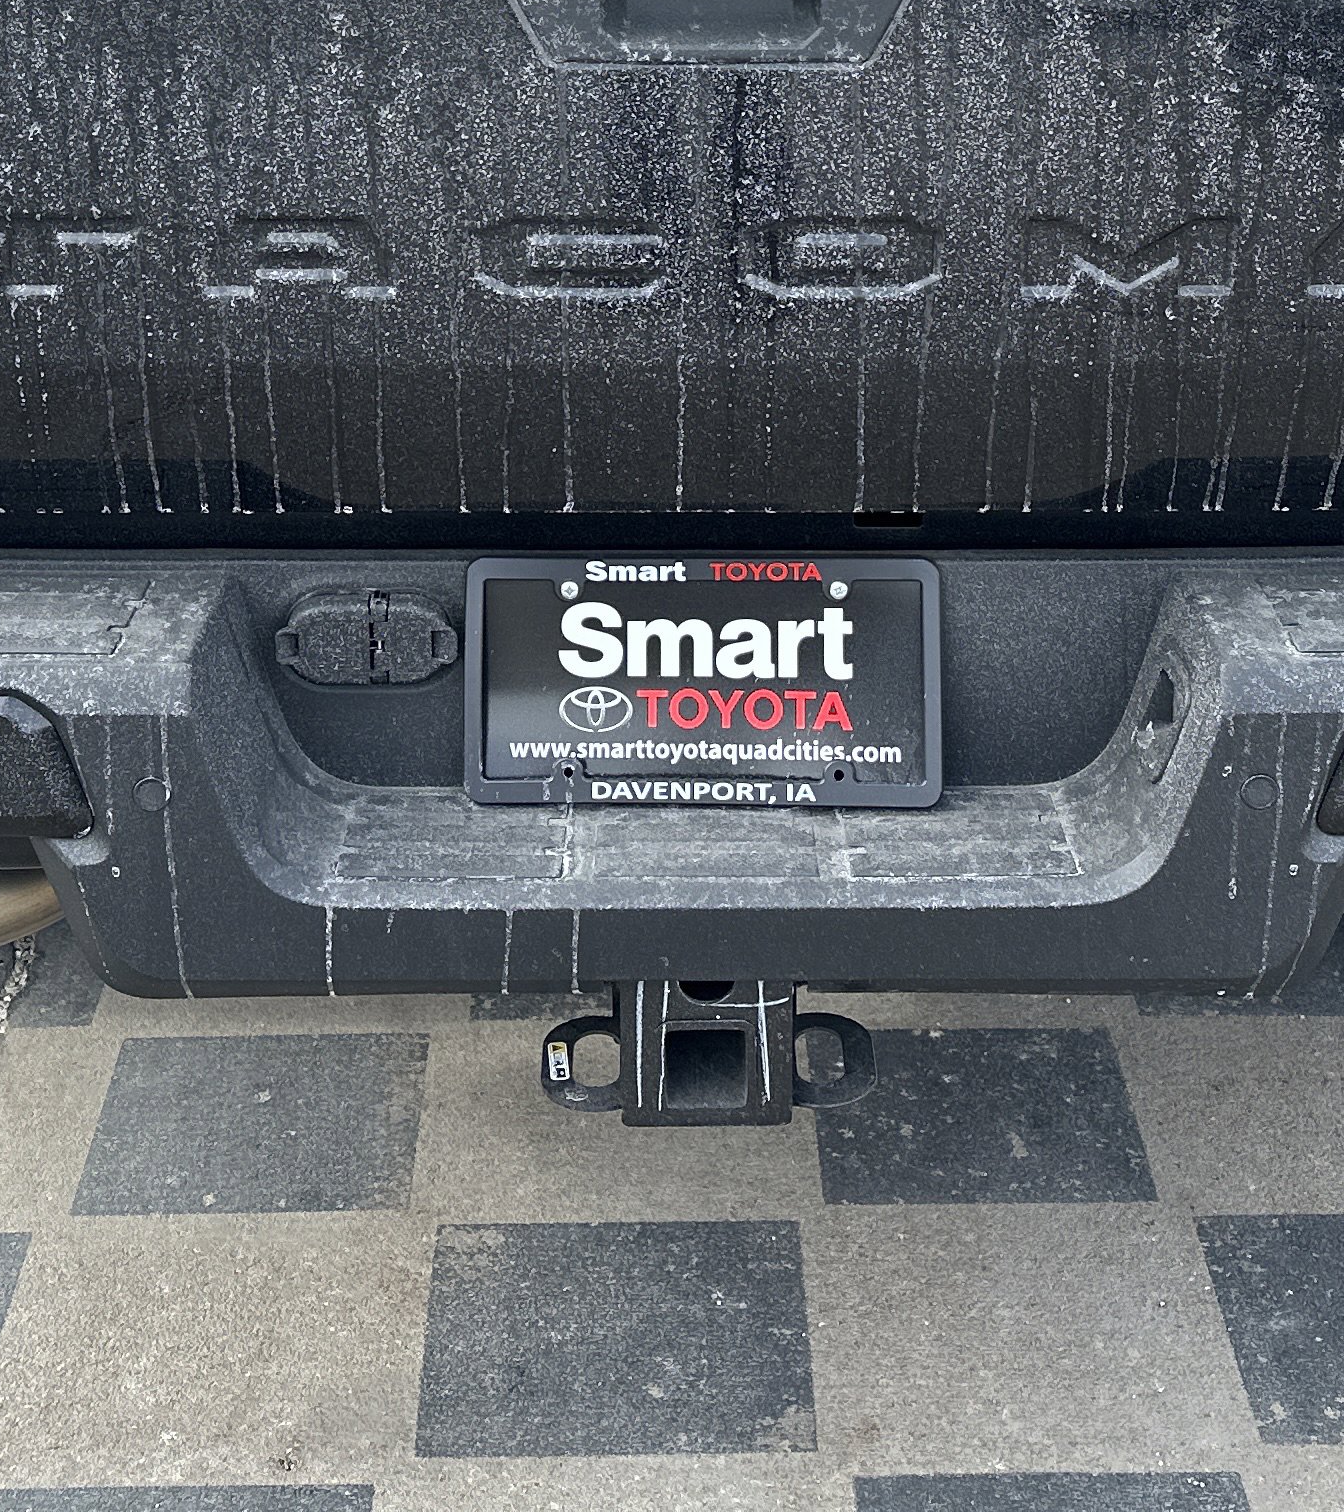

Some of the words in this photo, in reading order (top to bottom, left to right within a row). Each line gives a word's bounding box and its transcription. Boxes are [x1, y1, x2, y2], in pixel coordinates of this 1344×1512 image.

[585, 560, 687, 582] Smart
[709, 561, 823, 582] TOYOTA
[558, 601, 854, 681] Smart
[635, 687, 854, 732] TOYOTA
[509, 738, 902, 765] www.smarttoyotaquadcities.com
[591, 780, 777, 805] DAVENPORT,
[786, 783, 817, 803] IA
